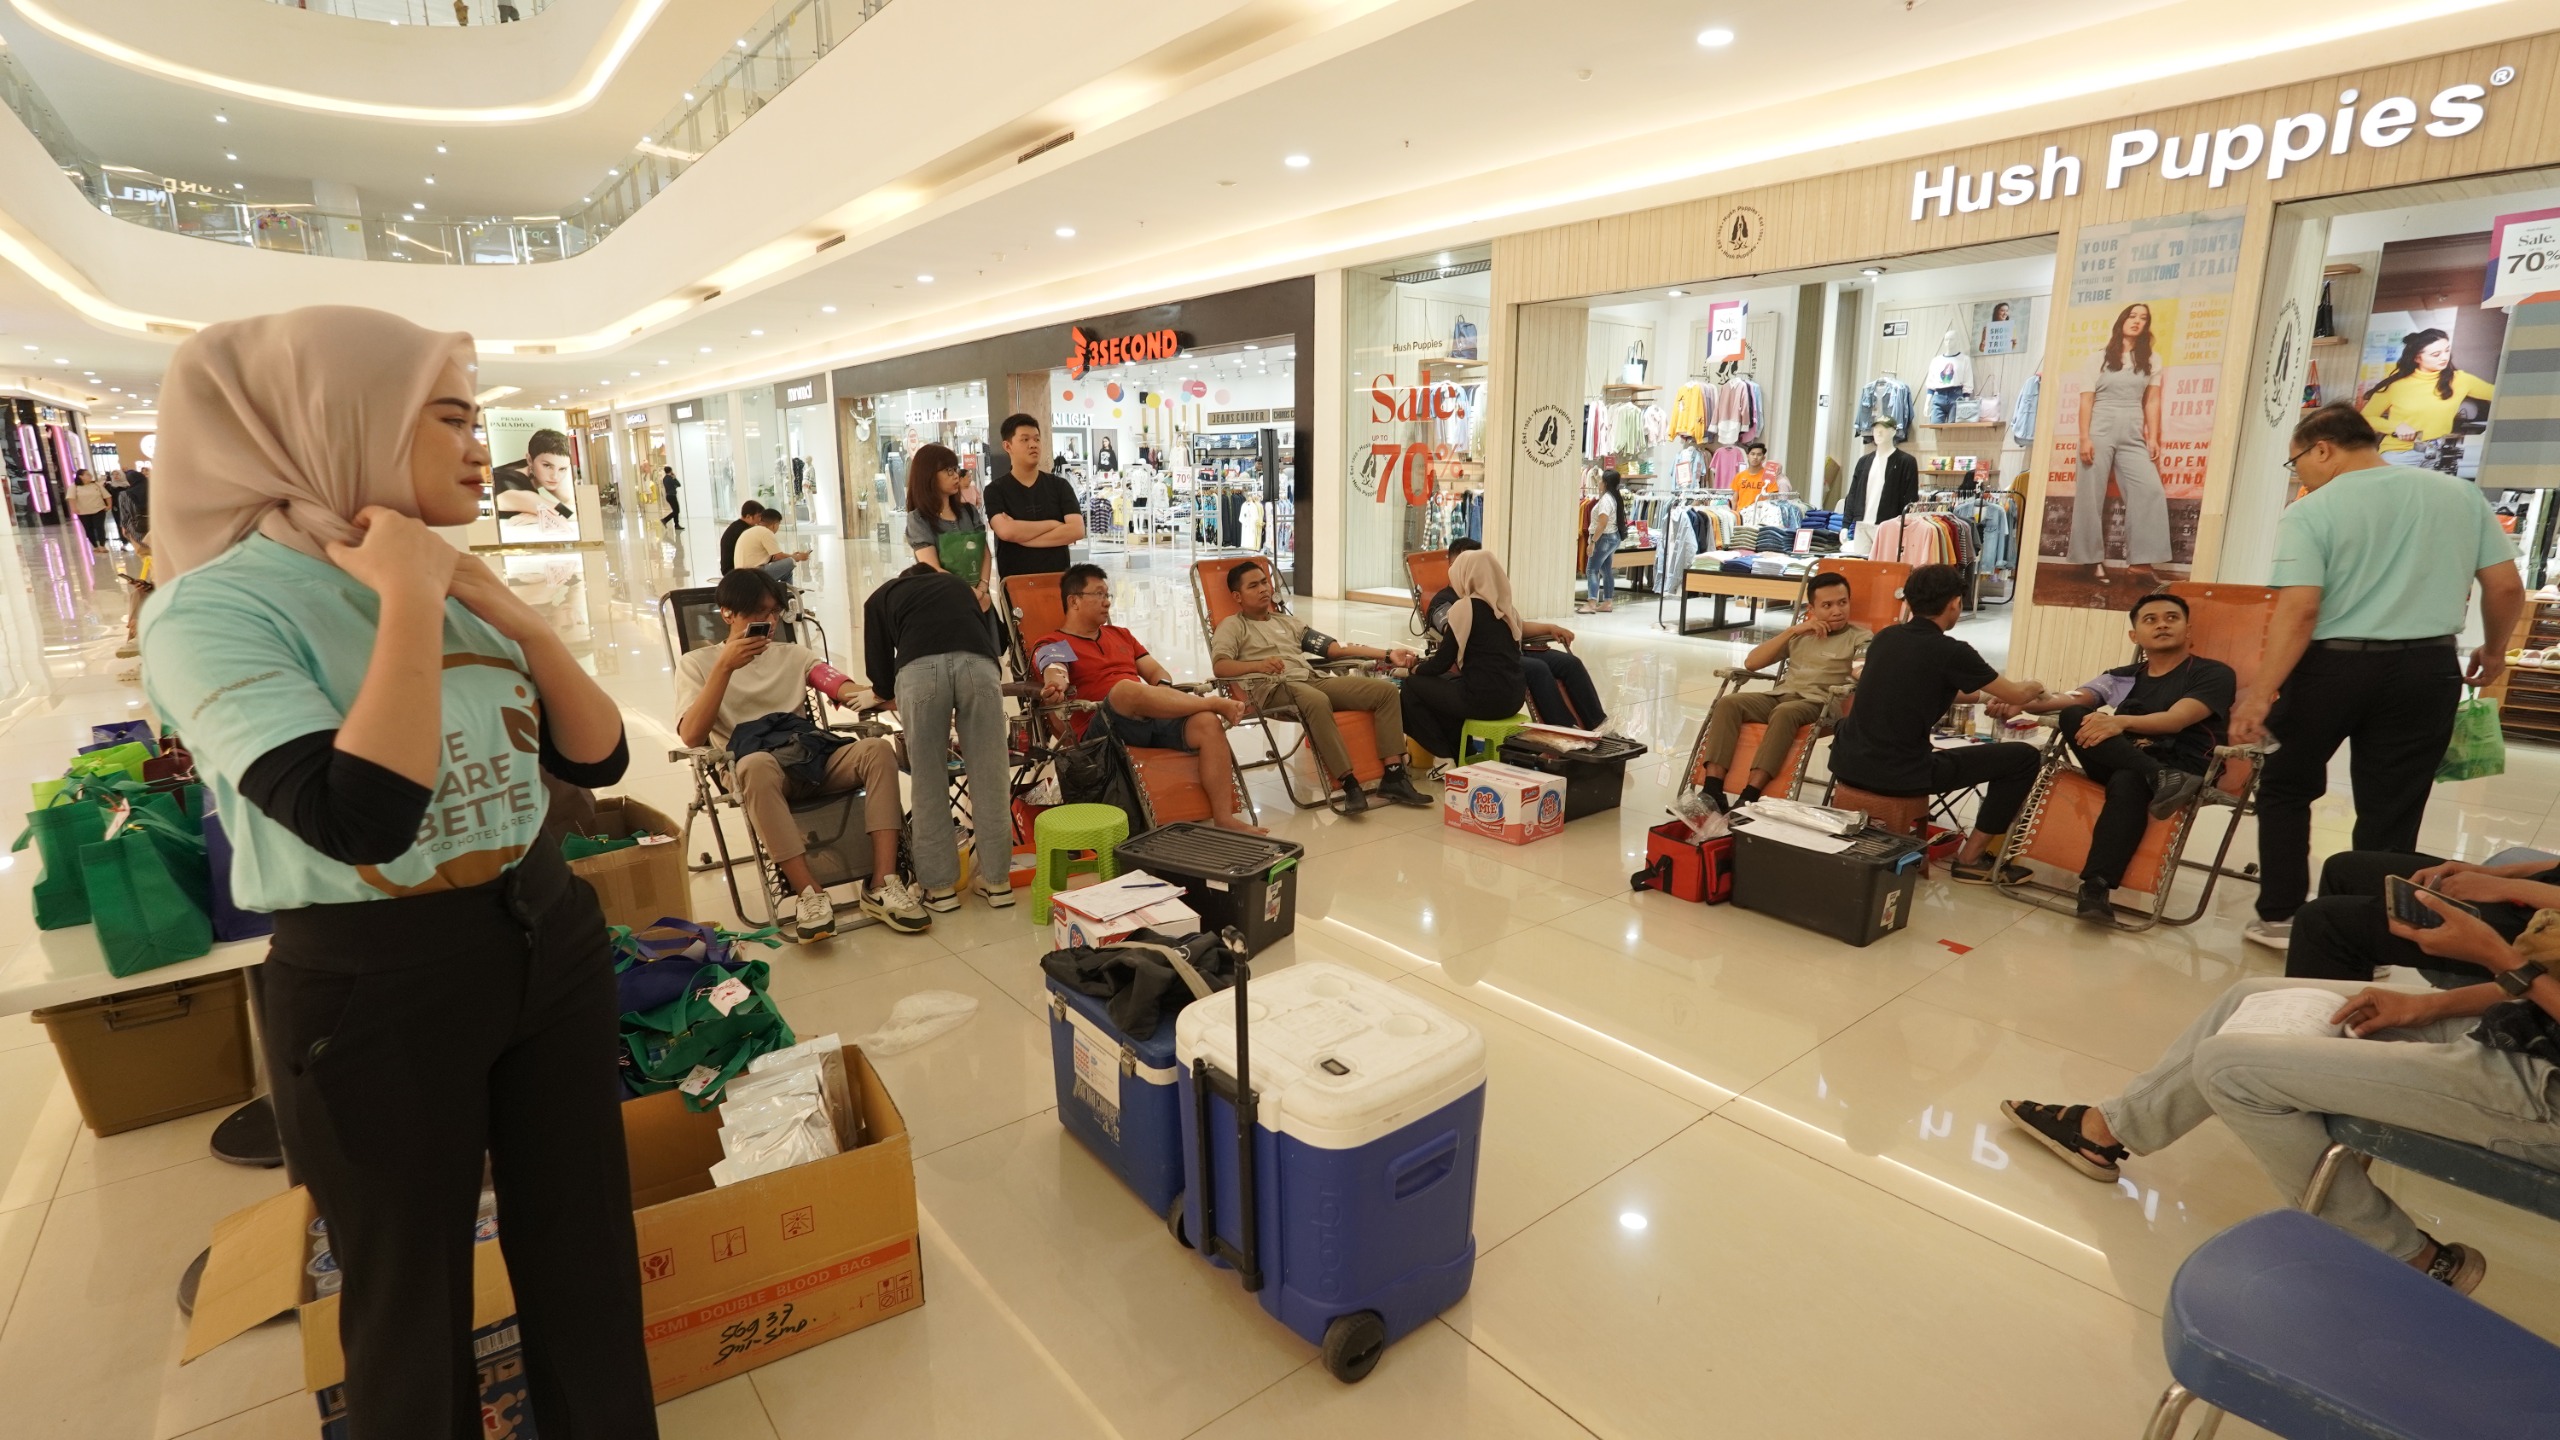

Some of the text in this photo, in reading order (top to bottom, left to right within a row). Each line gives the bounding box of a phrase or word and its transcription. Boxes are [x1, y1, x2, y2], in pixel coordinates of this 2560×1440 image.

[1911, 83, 2486, 221] Hush Puppies
[2083, 239, 2118, 254] YOUR
[2131, 240, 2184, 262] TALK TO
[2081, 257, 2117, 272] VIBE
[2127, 263, 2180, 284] EVERYONE
[2077, 288, 2112, 303] TRIBE
[2190, 309, 2225, 319] SONGS
[2186, 330, 2221, 340] POEMS
[1089, 329, 1178, 366] 3SECOND
[1393, 339, 1443, 352] Hush Puppies
[2183, 350, 2218, 360] JOKES
[2177, 378, 2214, 395] SAY HI
[1371, 370, 1465, 424] Sale.
[1533, 404, 1572, 425] Hush Puppies
[2170, 400, 2214, 416] FIRST
[904, 407, 945, 425] GREENLIGHT
[1050, 412, 1095, 427] NLIGHT
[1212, 412, 1264, 423] JEANS CORNER
[2165, 441, 2209, 450] HAVE AN
[1525, 448, 1539, 463] Hush
[2163, 456, 2206, 467] OPEN
[1741, 479, 1762, 490] SALE
[2161, 473, 2205, 485] MIND
[1475, 792, 1493, 804] POP
[415, 780, 536, 848] BETTE
[1478, 803, 1497, 814] MIE
[457, 828, 500, 846] HOTEL
[501, 822, 509, 831] &
[643, 1255, 872, 1342] ARMI DOUBLE BLOOD BAG
